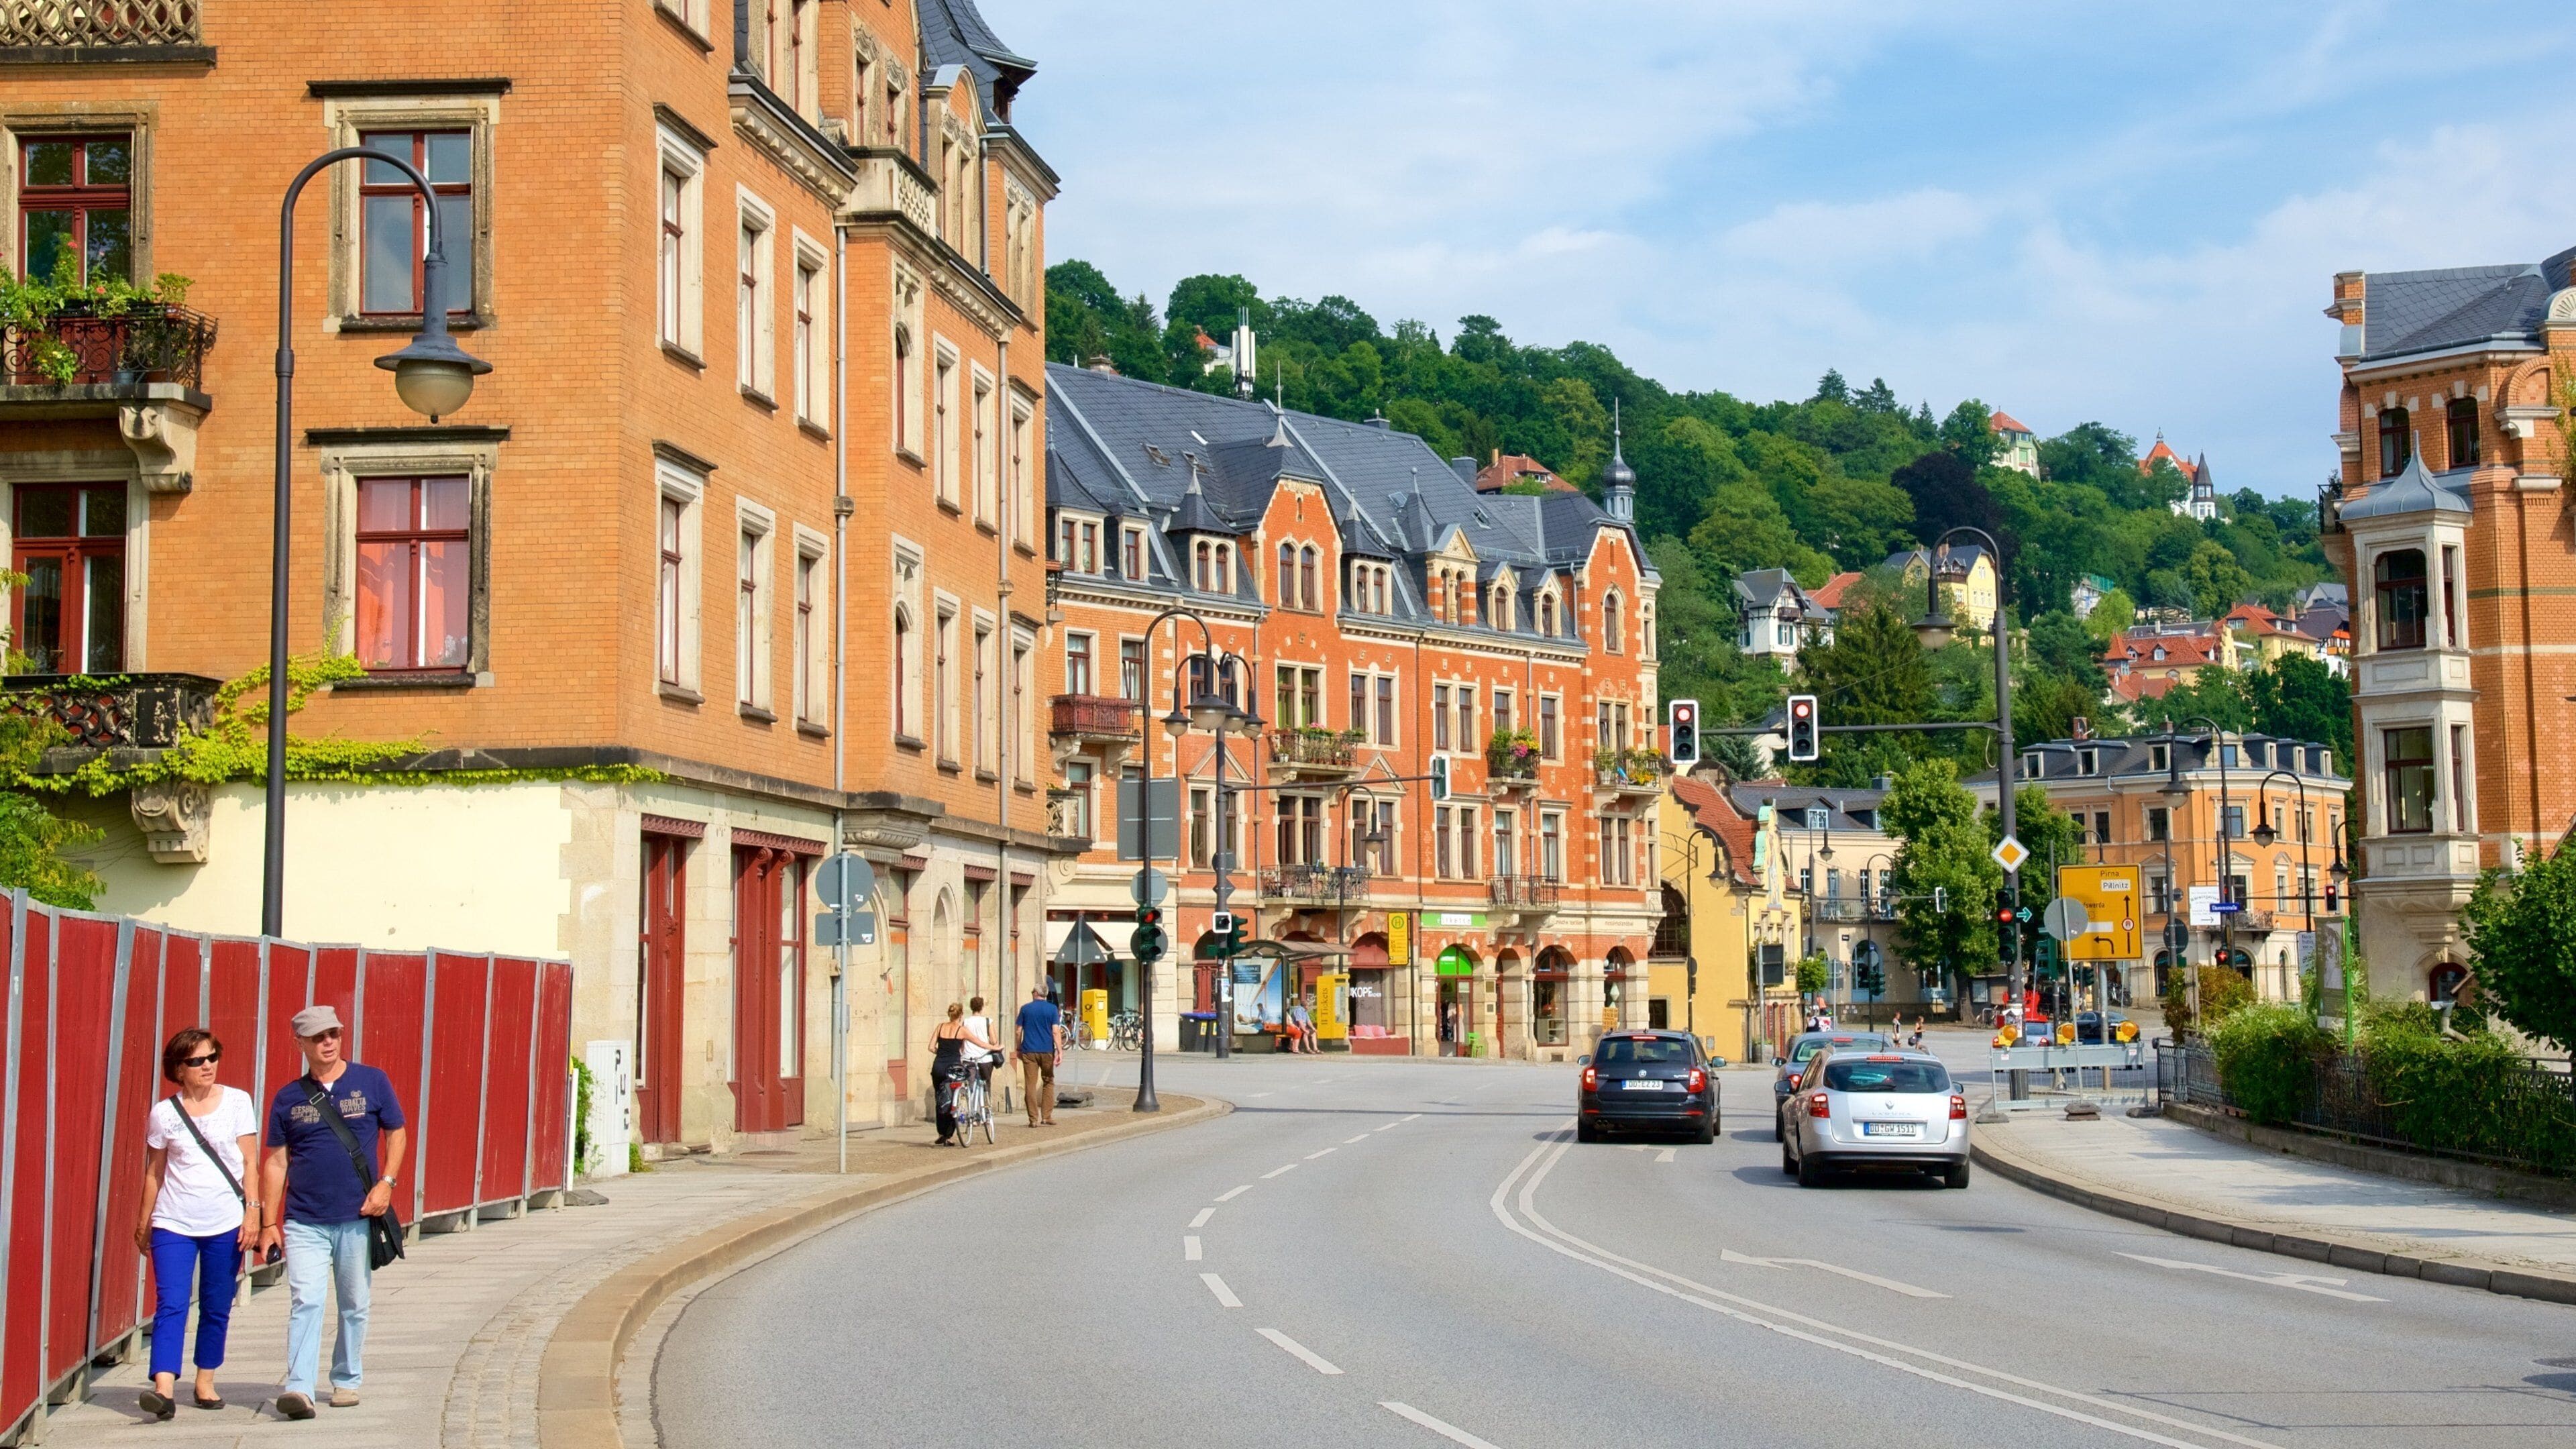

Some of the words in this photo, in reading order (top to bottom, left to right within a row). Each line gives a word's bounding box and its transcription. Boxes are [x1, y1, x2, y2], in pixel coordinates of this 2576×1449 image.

[340, 1097, 366, 1107] REGATTA
[341, 1105, 366, 1114] WAVES
[1870, 1124, 1880, 1133] DD
[1896, 1124, 1915, 1133] 1511
